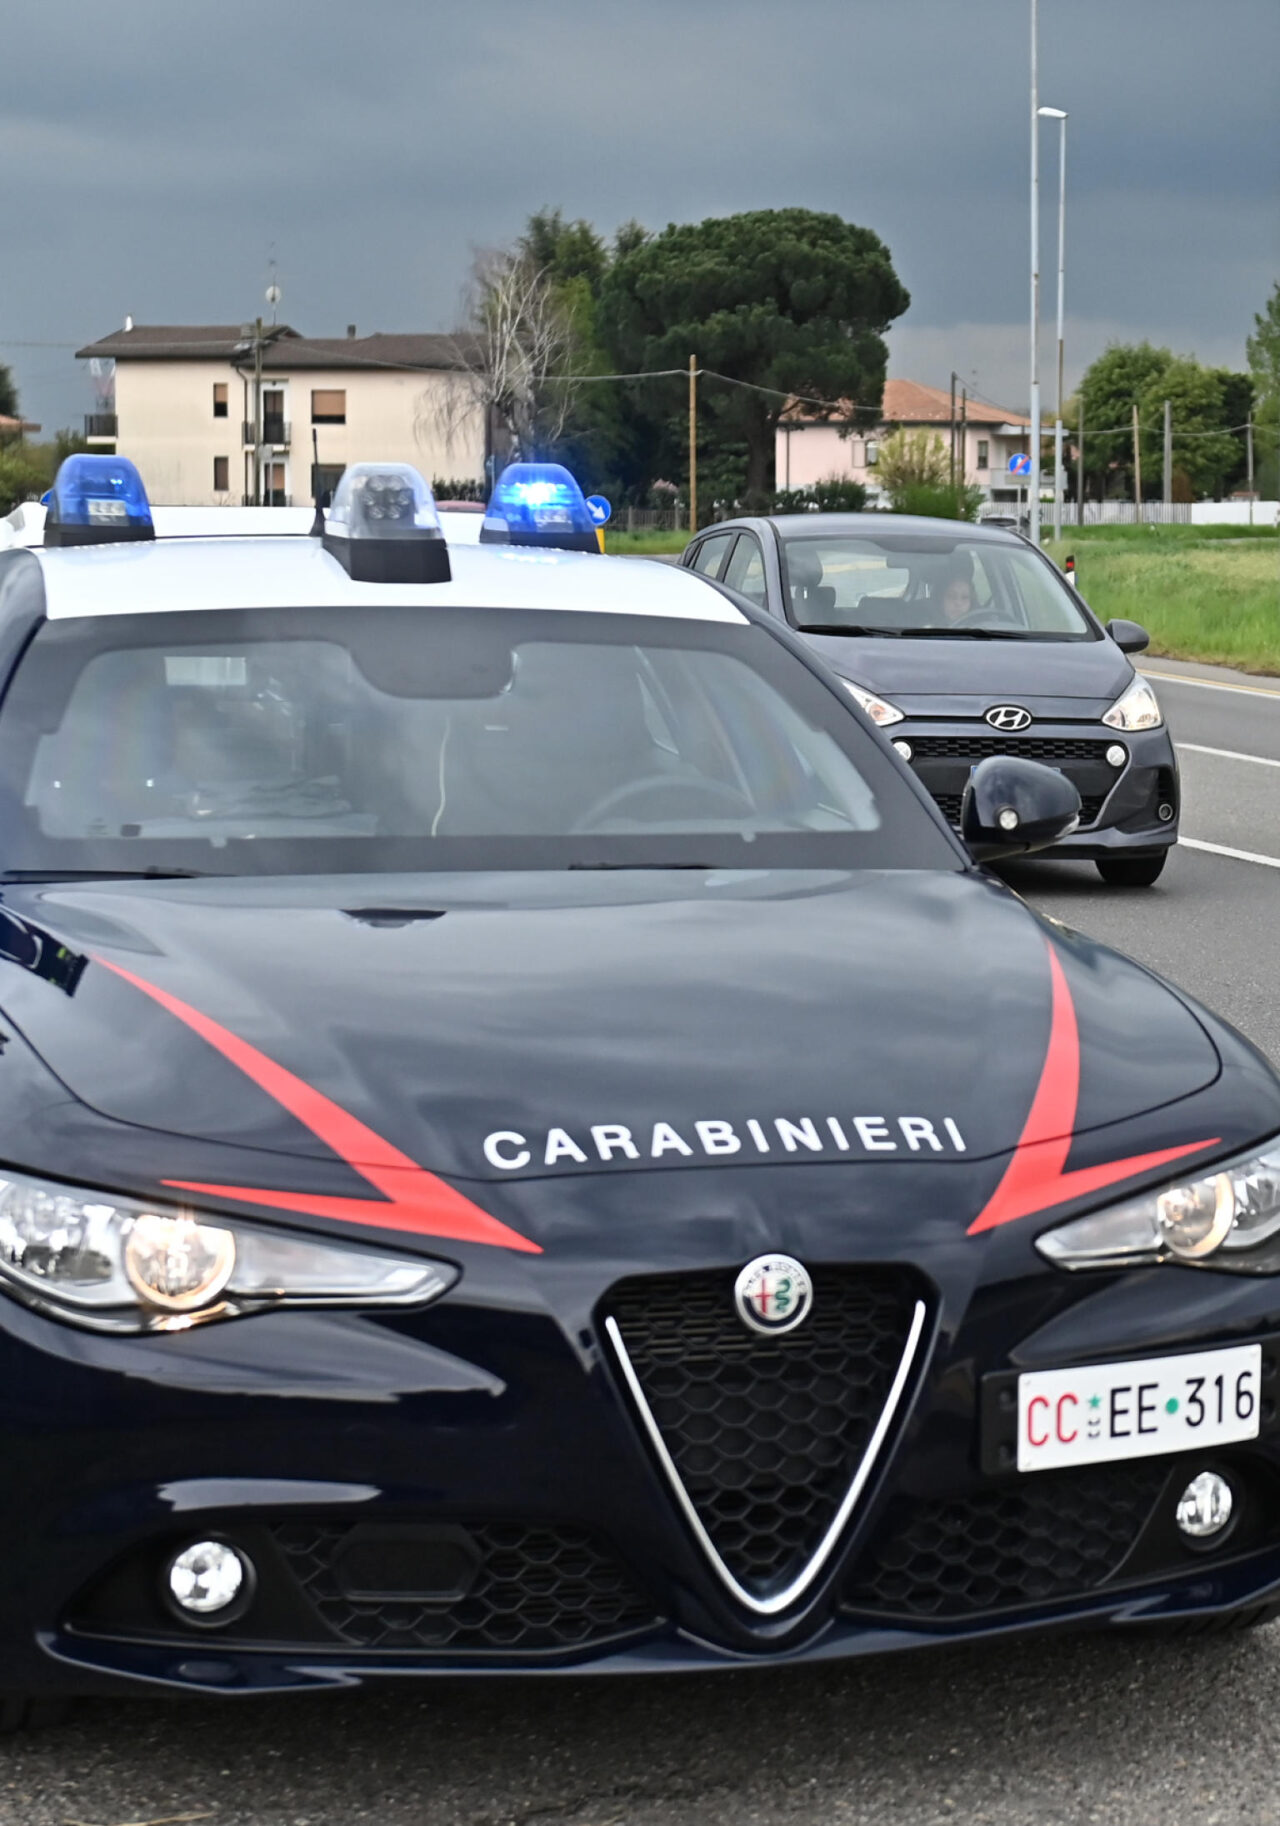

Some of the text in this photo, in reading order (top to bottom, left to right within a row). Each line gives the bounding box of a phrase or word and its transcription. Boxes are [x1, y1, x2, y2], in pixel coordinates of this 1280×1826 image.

[483, 1116, 967, 1170] CARABINIERI
[1027, 1370, 1255, 1447] CC EE 316
